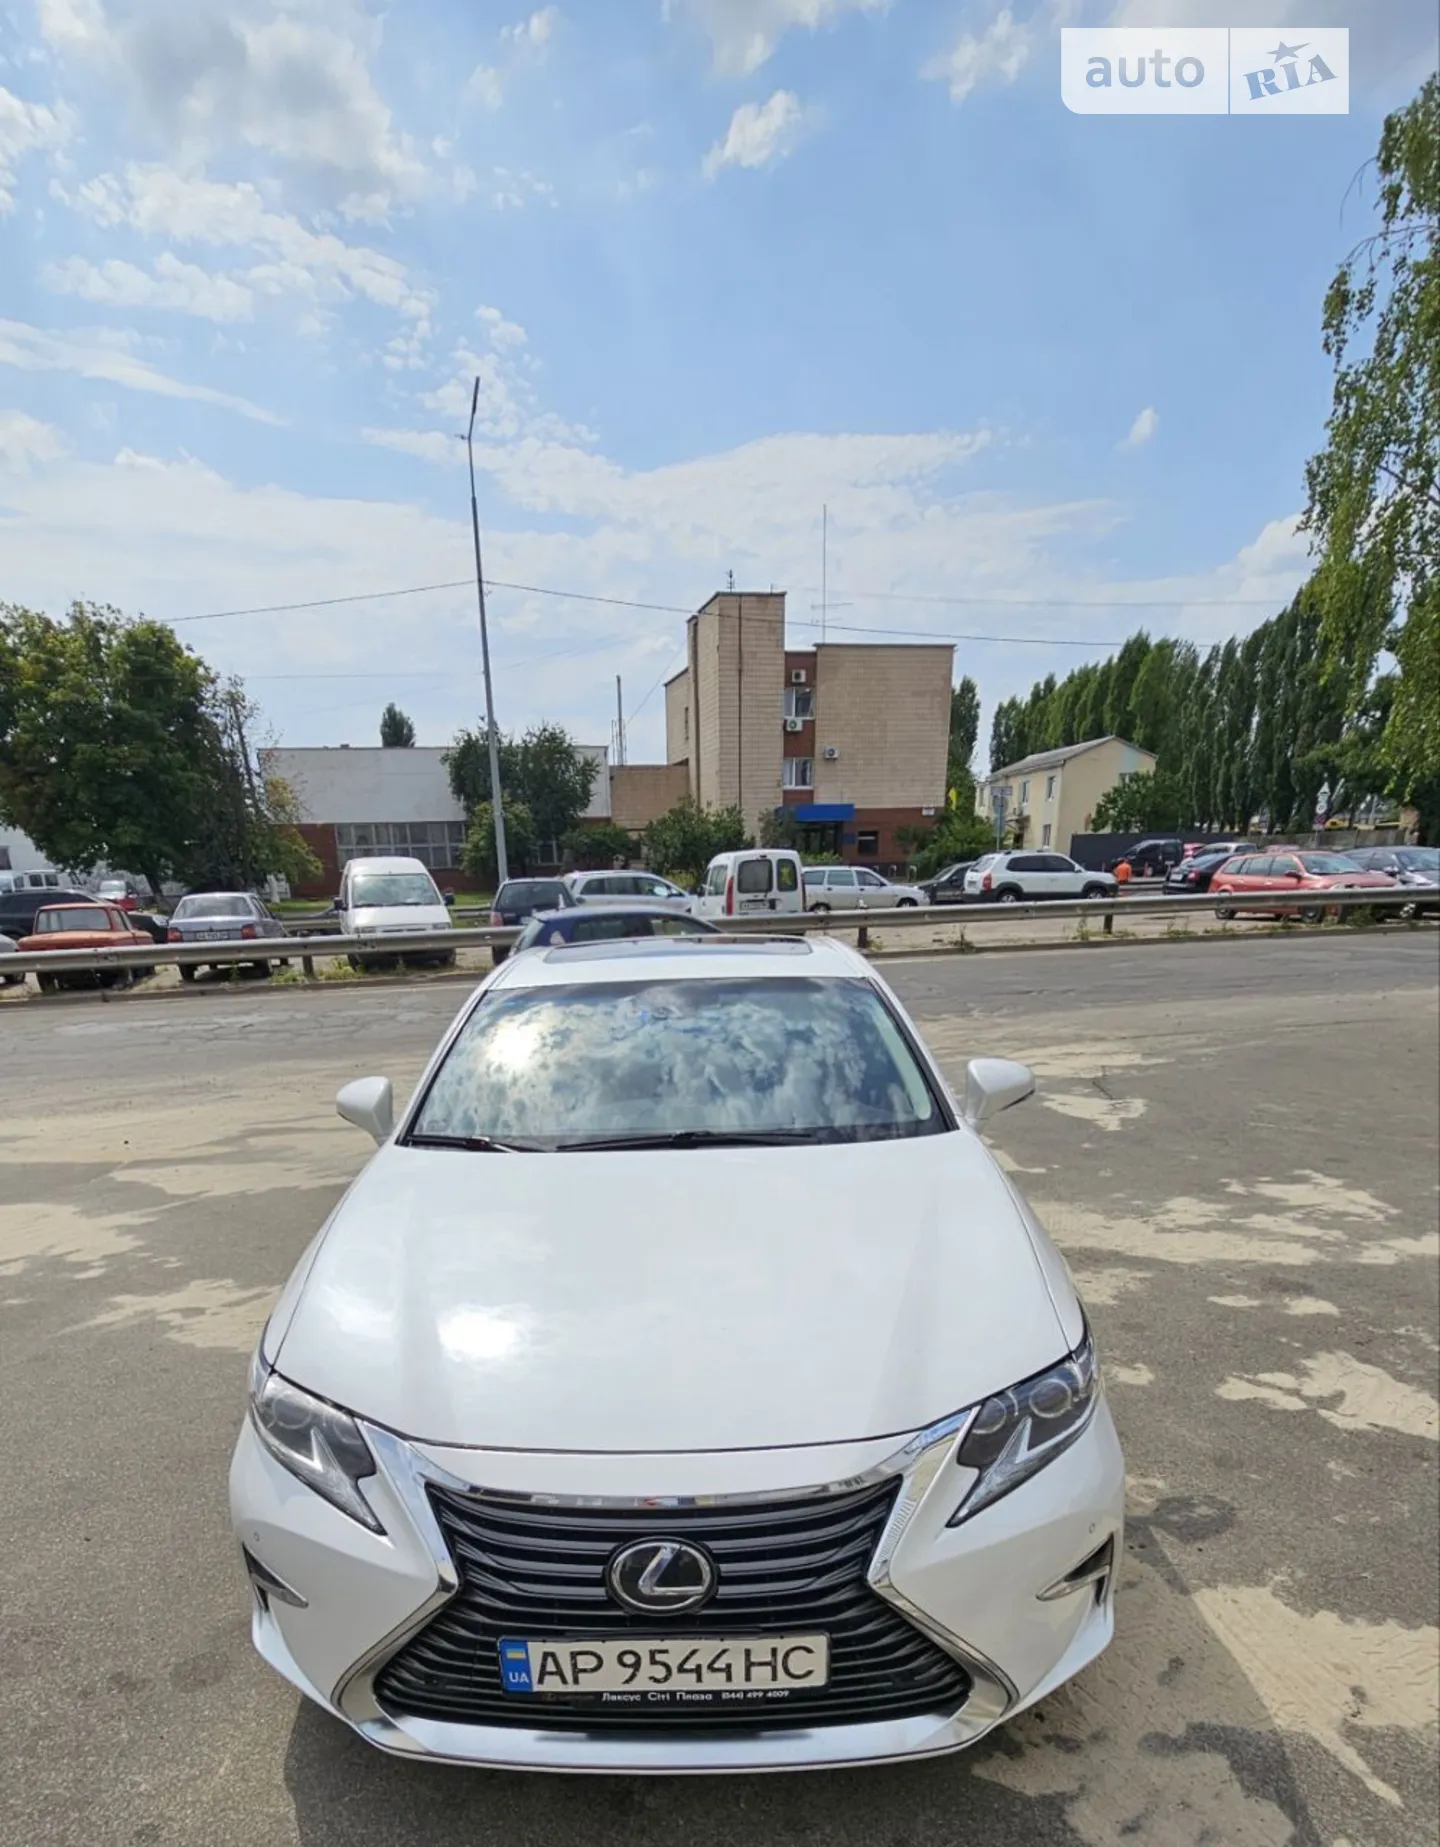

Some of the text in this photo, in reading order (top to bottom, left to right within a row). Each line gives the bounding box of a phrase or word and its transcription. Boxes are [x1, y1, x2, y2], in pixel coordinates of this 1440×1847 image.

[508, 1671, 530, 1684] UA
[537, 1645, 815, 1686] AP 9544 HC
